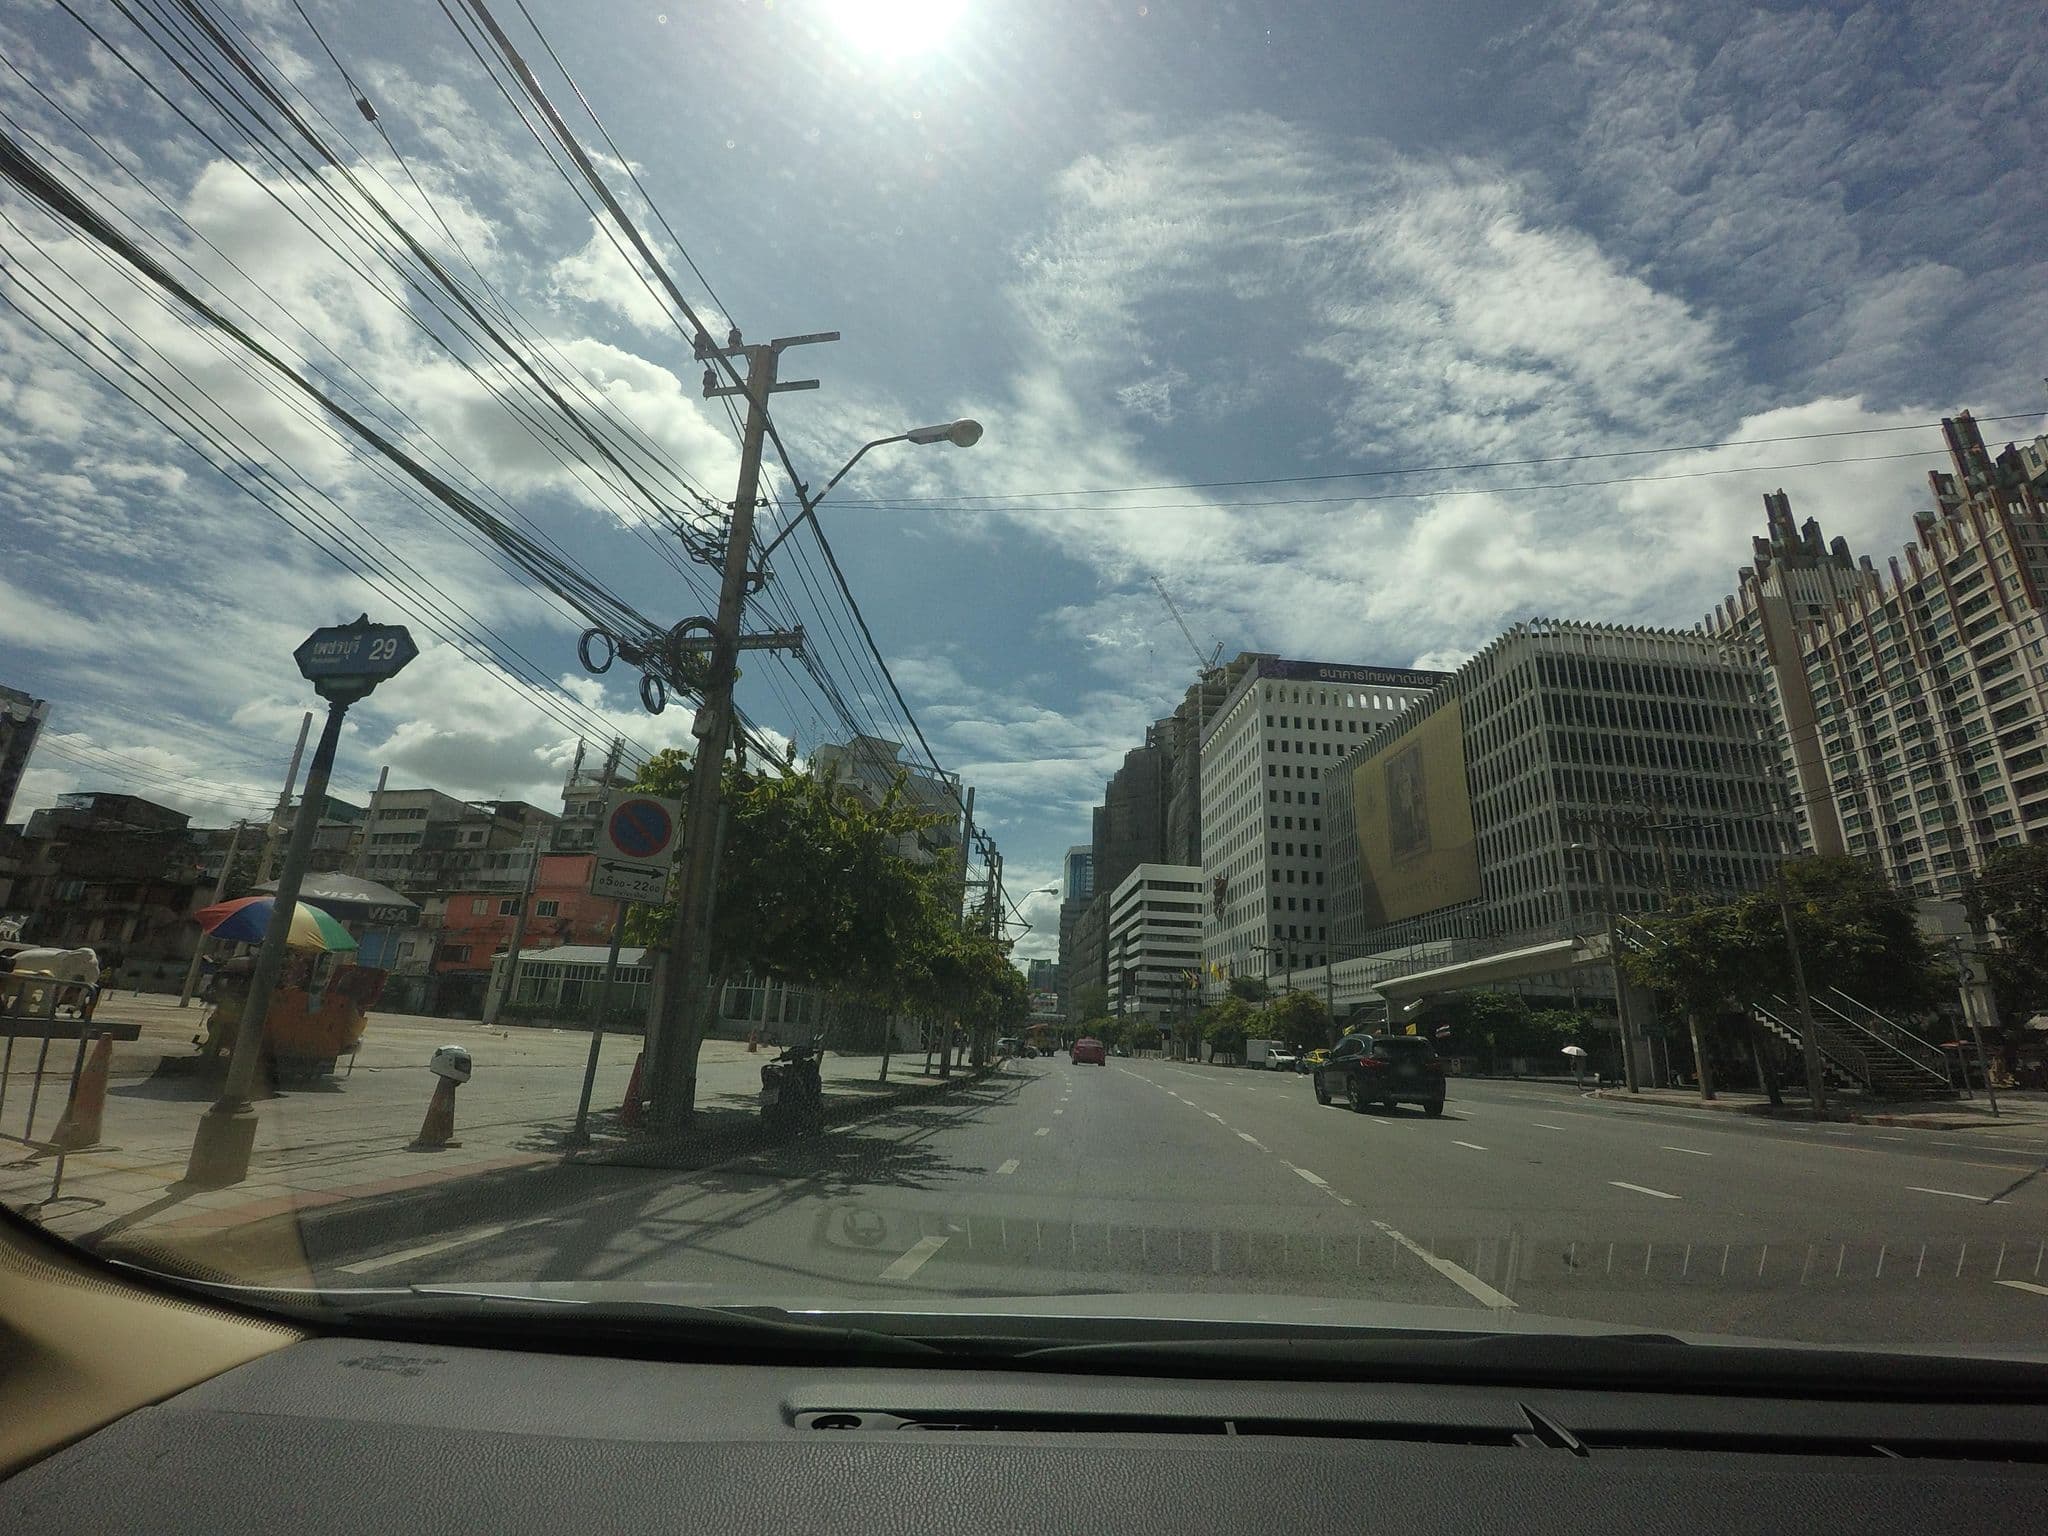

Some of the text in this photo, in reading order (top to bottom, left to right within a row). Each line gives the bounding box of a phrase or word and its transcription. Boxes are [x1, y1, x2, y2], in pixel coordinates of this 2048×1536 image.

[368, 638, 398, 661] 29
[313, 889, 370, 901] VISA
[368, 906, 408, 922] VISA
